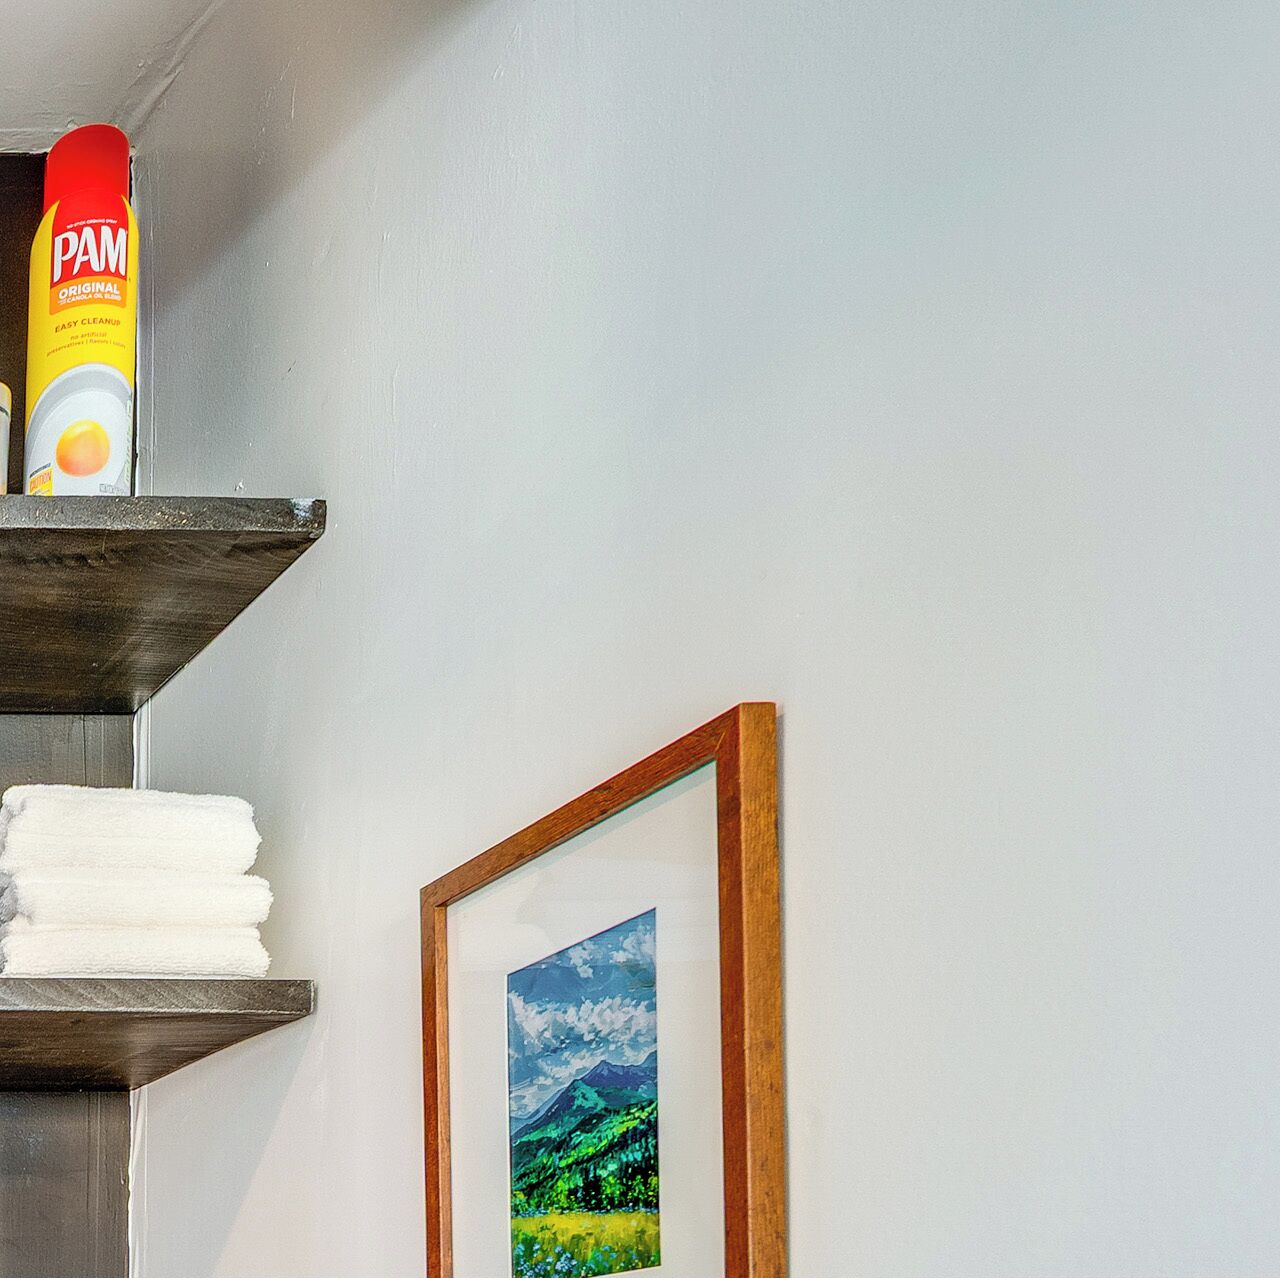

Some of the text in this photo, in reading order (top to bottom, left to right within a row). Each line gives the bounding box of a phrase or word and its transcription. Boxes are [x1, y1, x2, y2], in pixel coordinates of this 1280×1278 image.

[53, 225, 127, 283] PAM
[58, 282, 120, 300] ORIGINAL
[54, 317, 121, 334] EASY CLEANUP
